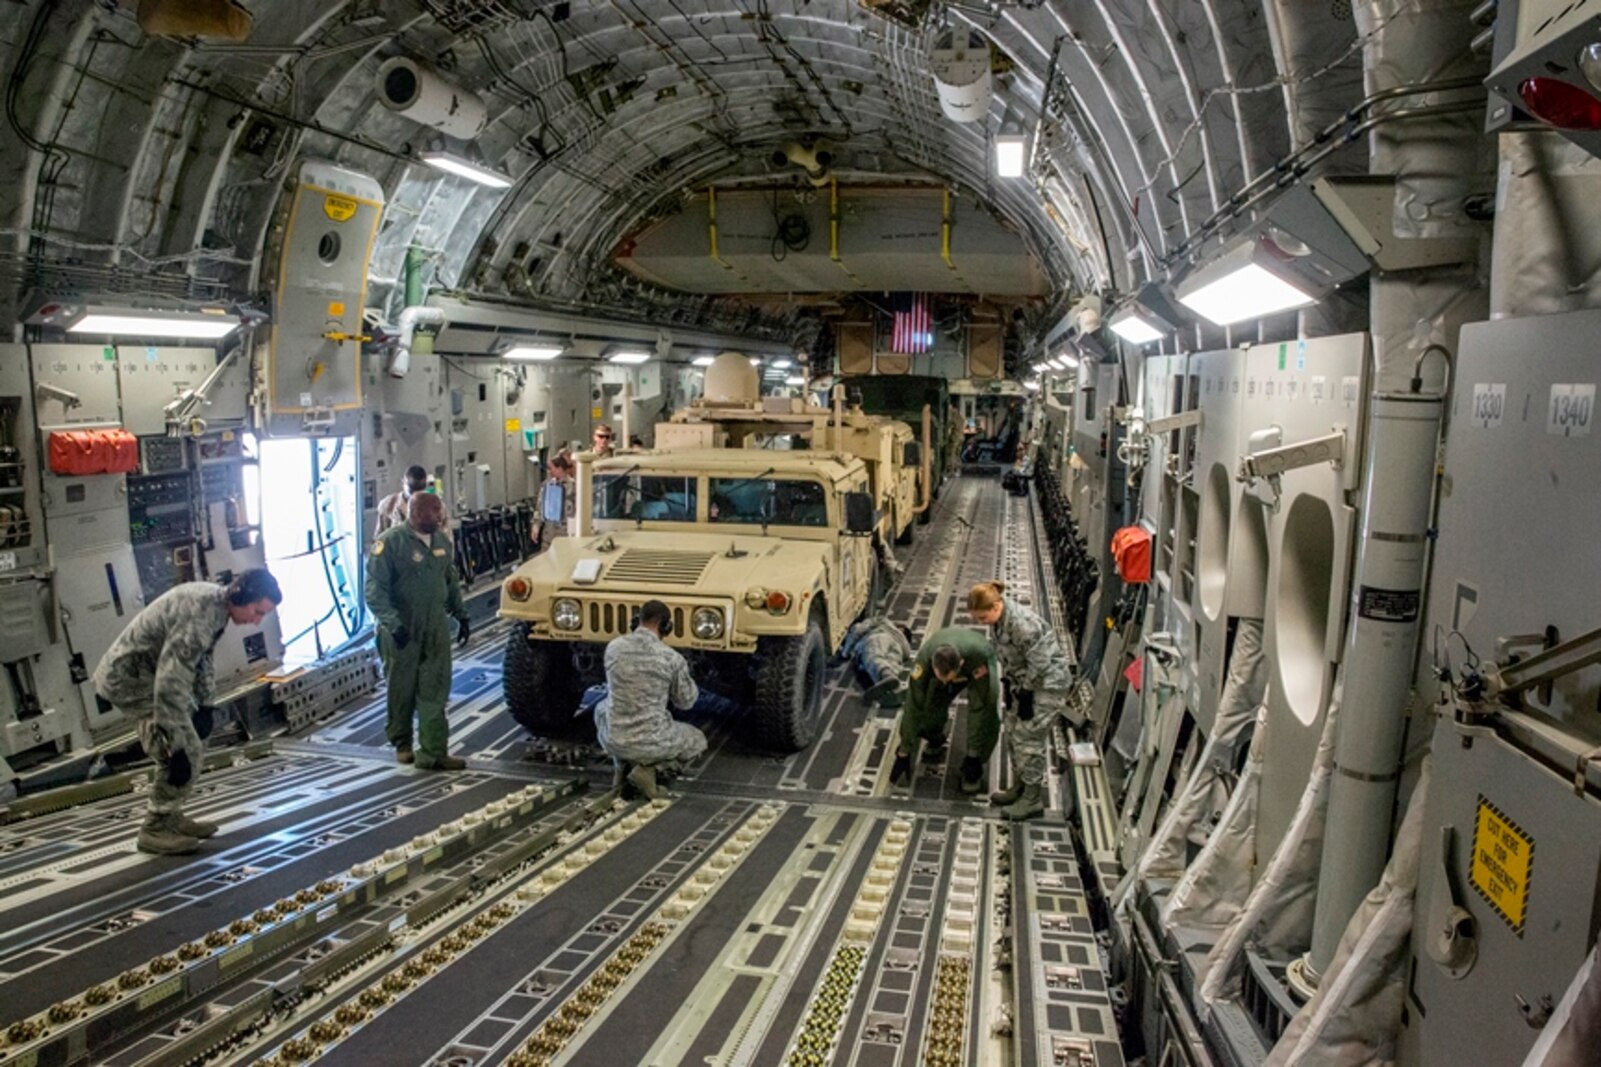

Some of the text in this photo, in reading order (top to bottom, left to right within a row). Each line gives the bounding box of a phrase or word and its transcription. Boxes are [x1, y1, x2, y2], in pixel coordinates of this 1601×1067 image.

[1475, 394, 1502, 420] 1330
[1553, 396, 1590, 426] 1340
[1488, 818, 1520, 857] CUT HERE
[1494, 843, 1507, 864] FOR
[1480, 849, 1518, 895] EMERGENCY
[1489, 878, 1504, 901] EXIT
